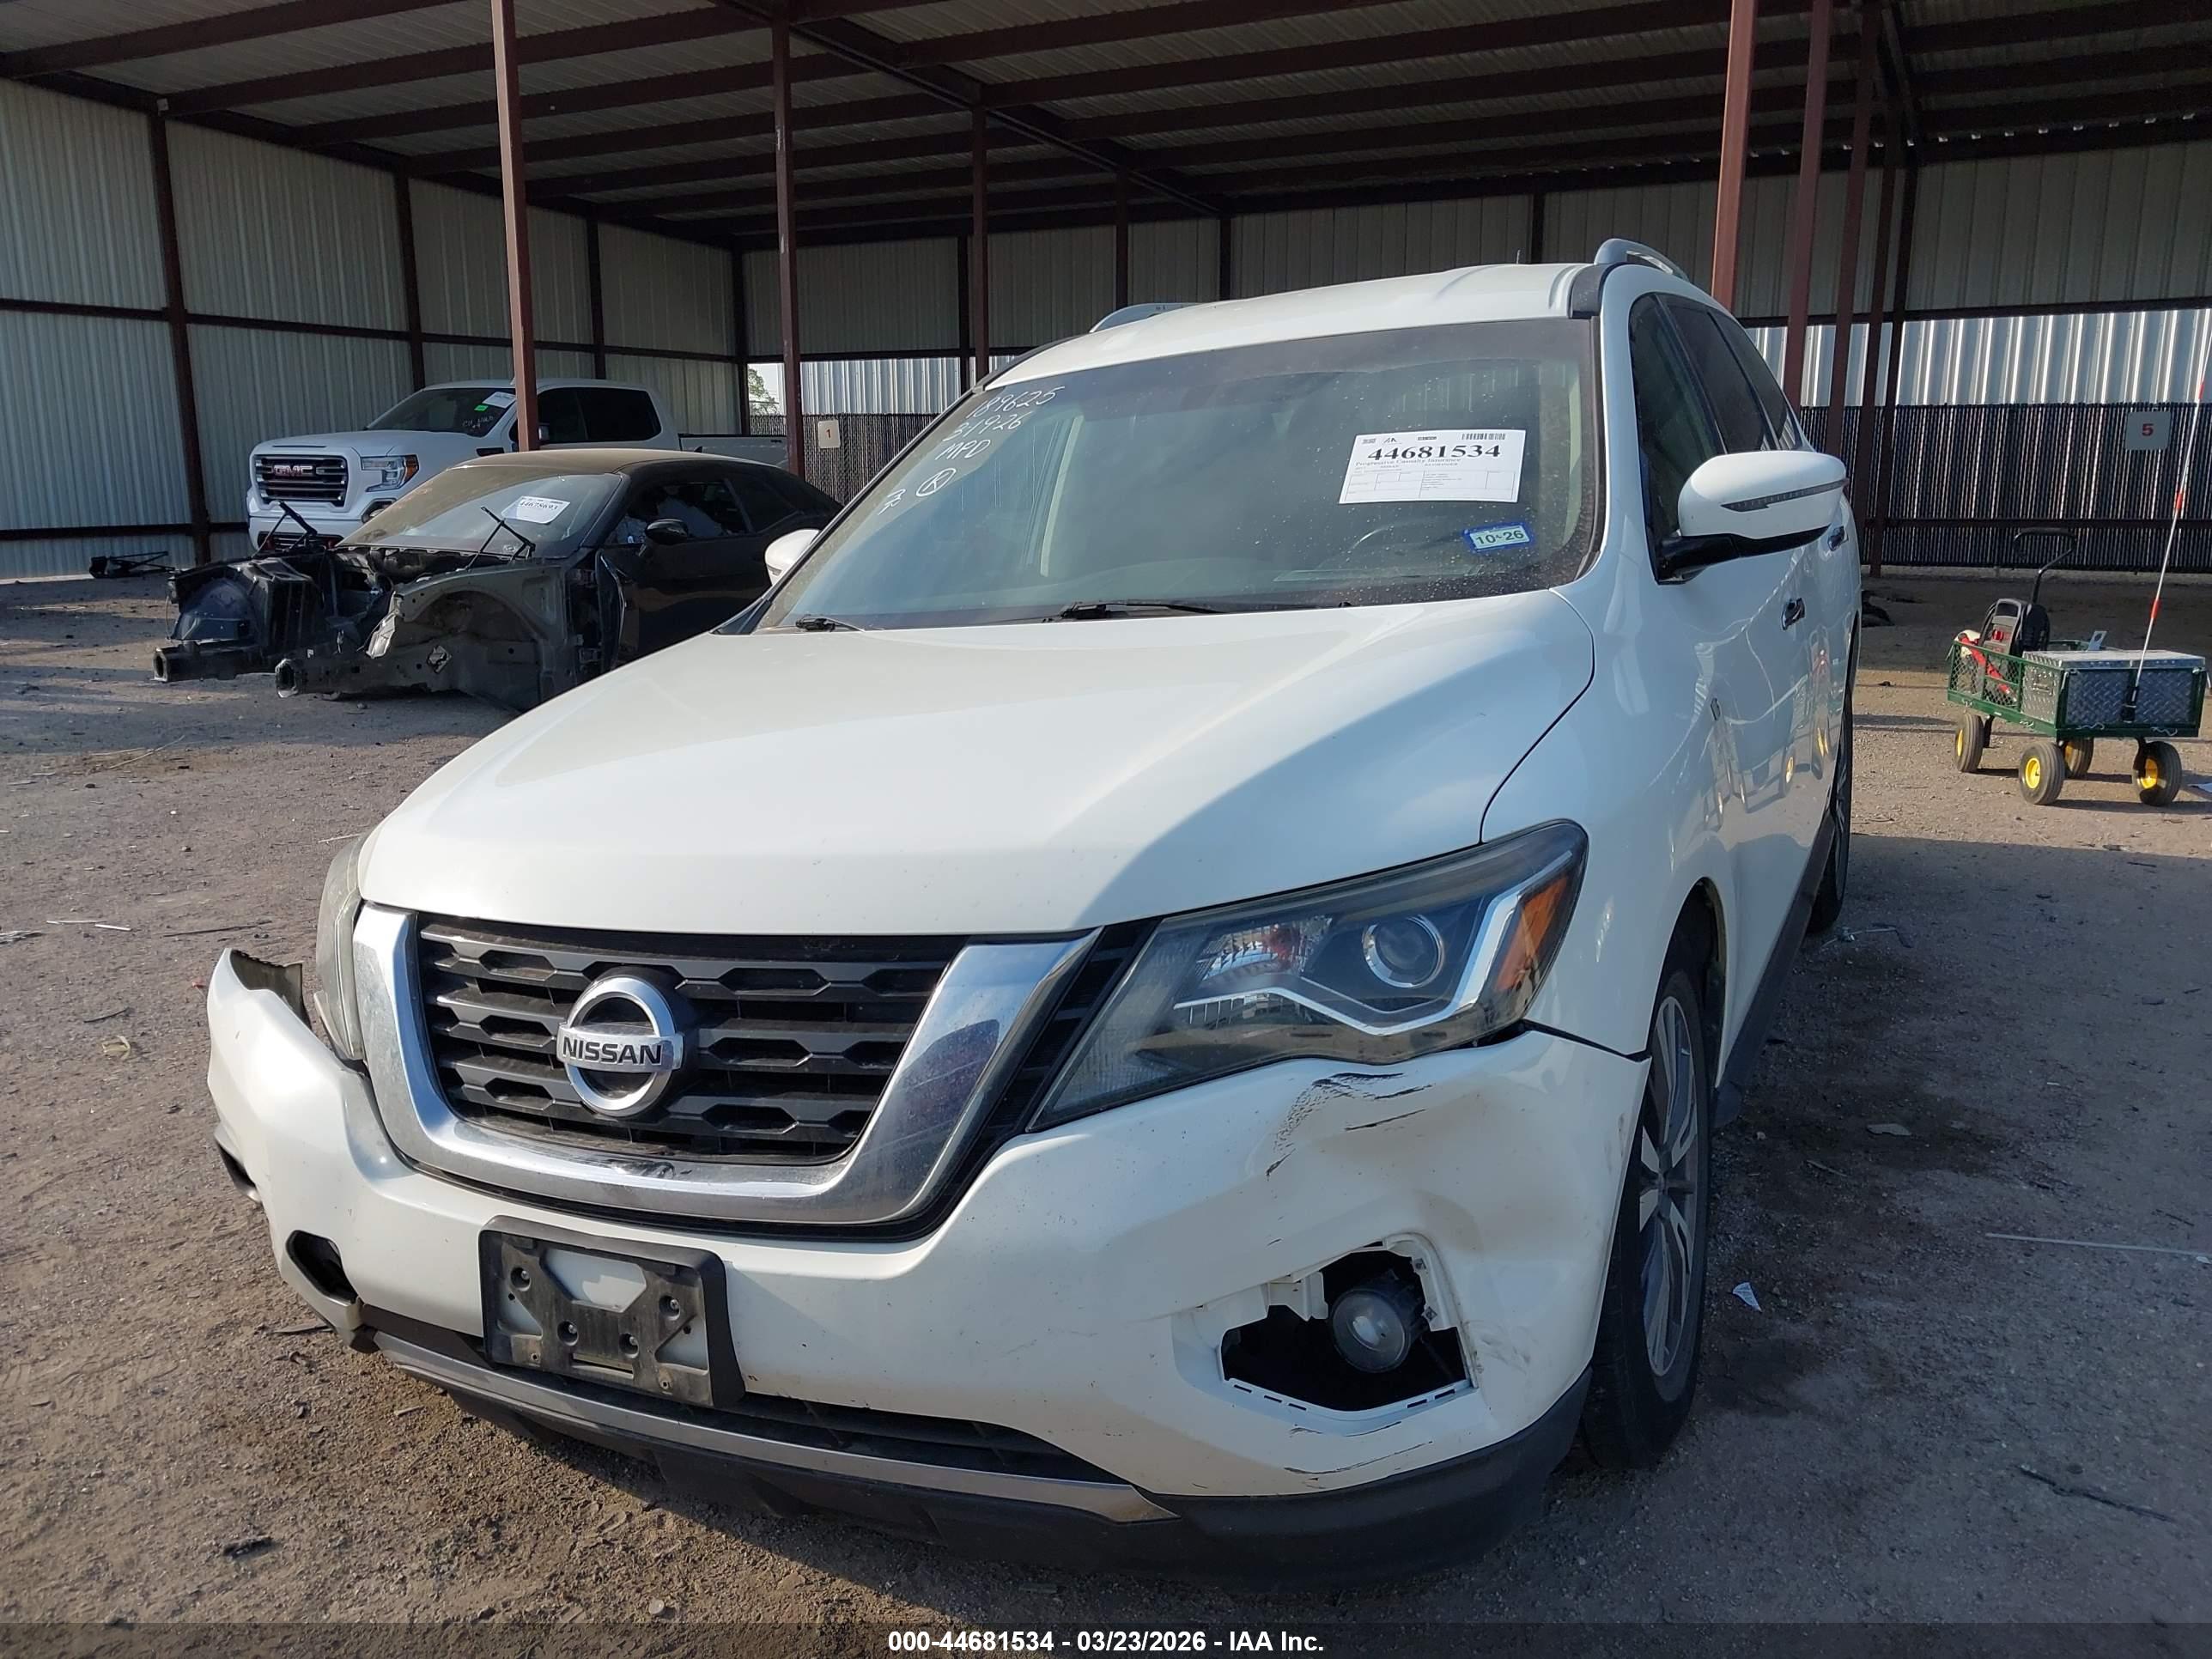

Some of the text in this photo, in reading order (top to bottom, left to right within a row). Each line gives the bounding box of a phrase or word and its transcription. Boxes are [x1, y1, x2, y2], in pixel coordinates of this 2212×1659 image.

[2142, 422, 2154, 437] 5
[934, 439, 991, 461] MPD
[1367, 444, 1501, 461] 44681534
[273, 465, 313, 477] GMC
[562, 1036, 662, 1066] NISSAN
